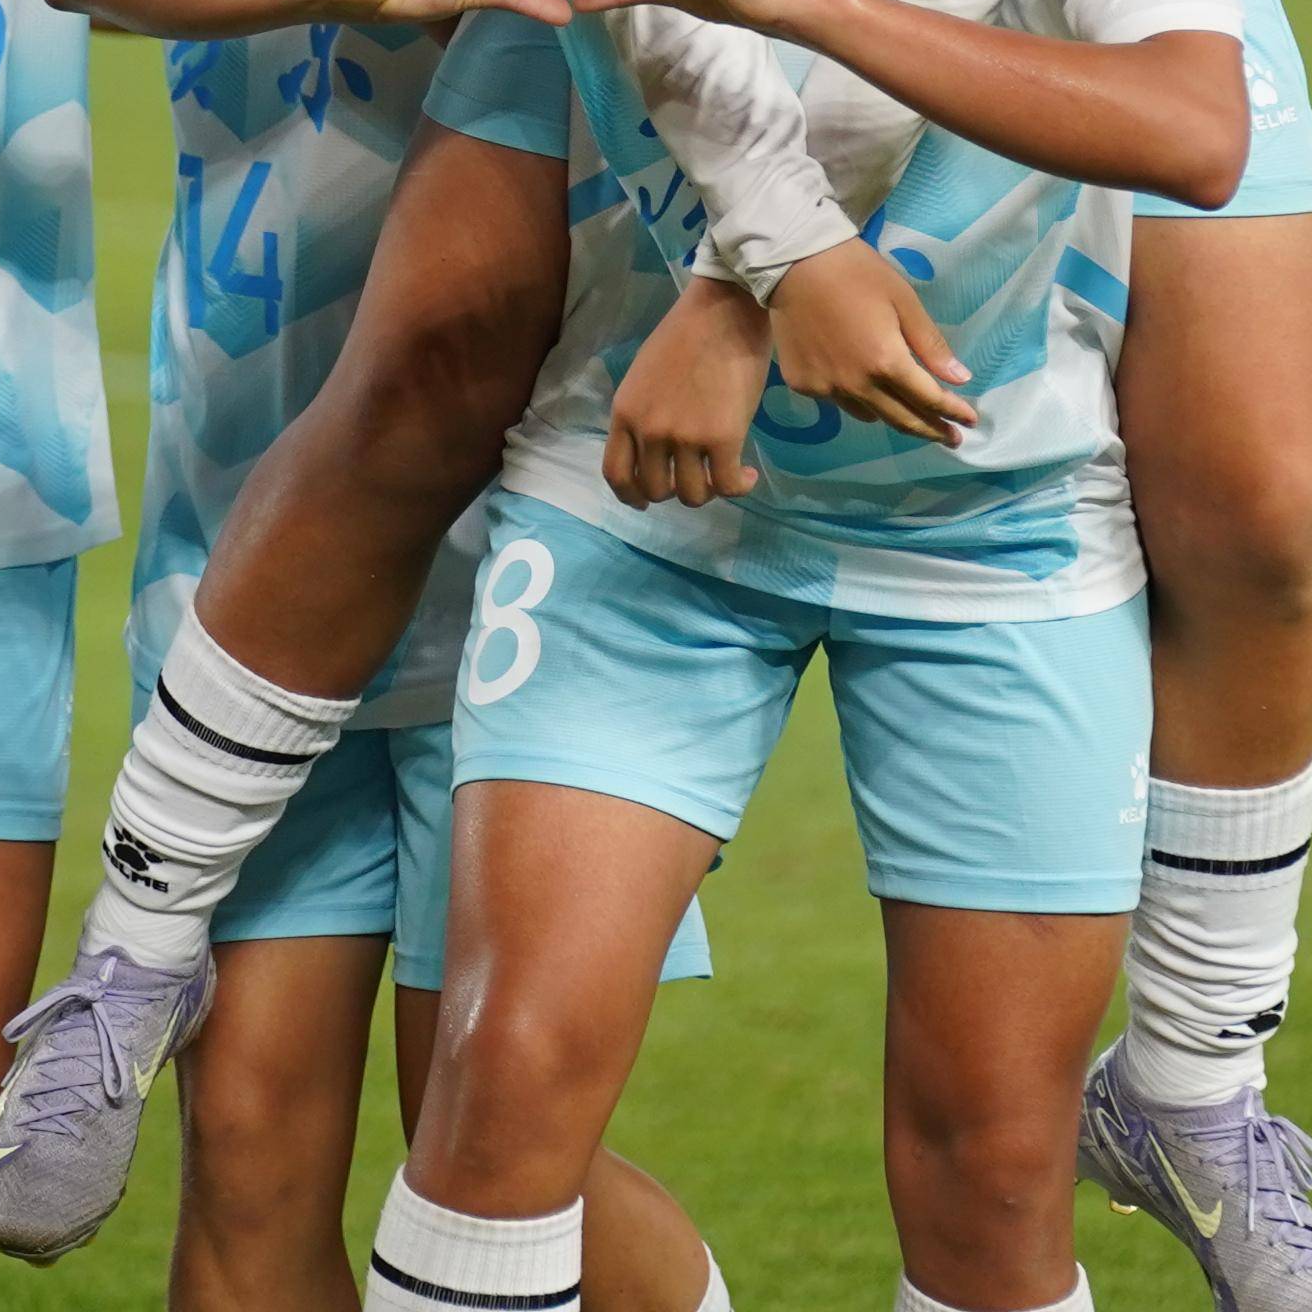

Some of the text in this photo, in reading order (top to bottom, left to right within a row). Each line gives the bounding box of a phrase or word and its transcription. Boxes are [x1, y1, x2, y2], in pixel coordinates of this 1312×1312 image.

[1251, 106, 1298, 131] ELME
[178, 152, 283, 336] 14
[467, 538, 556, 706] 8
